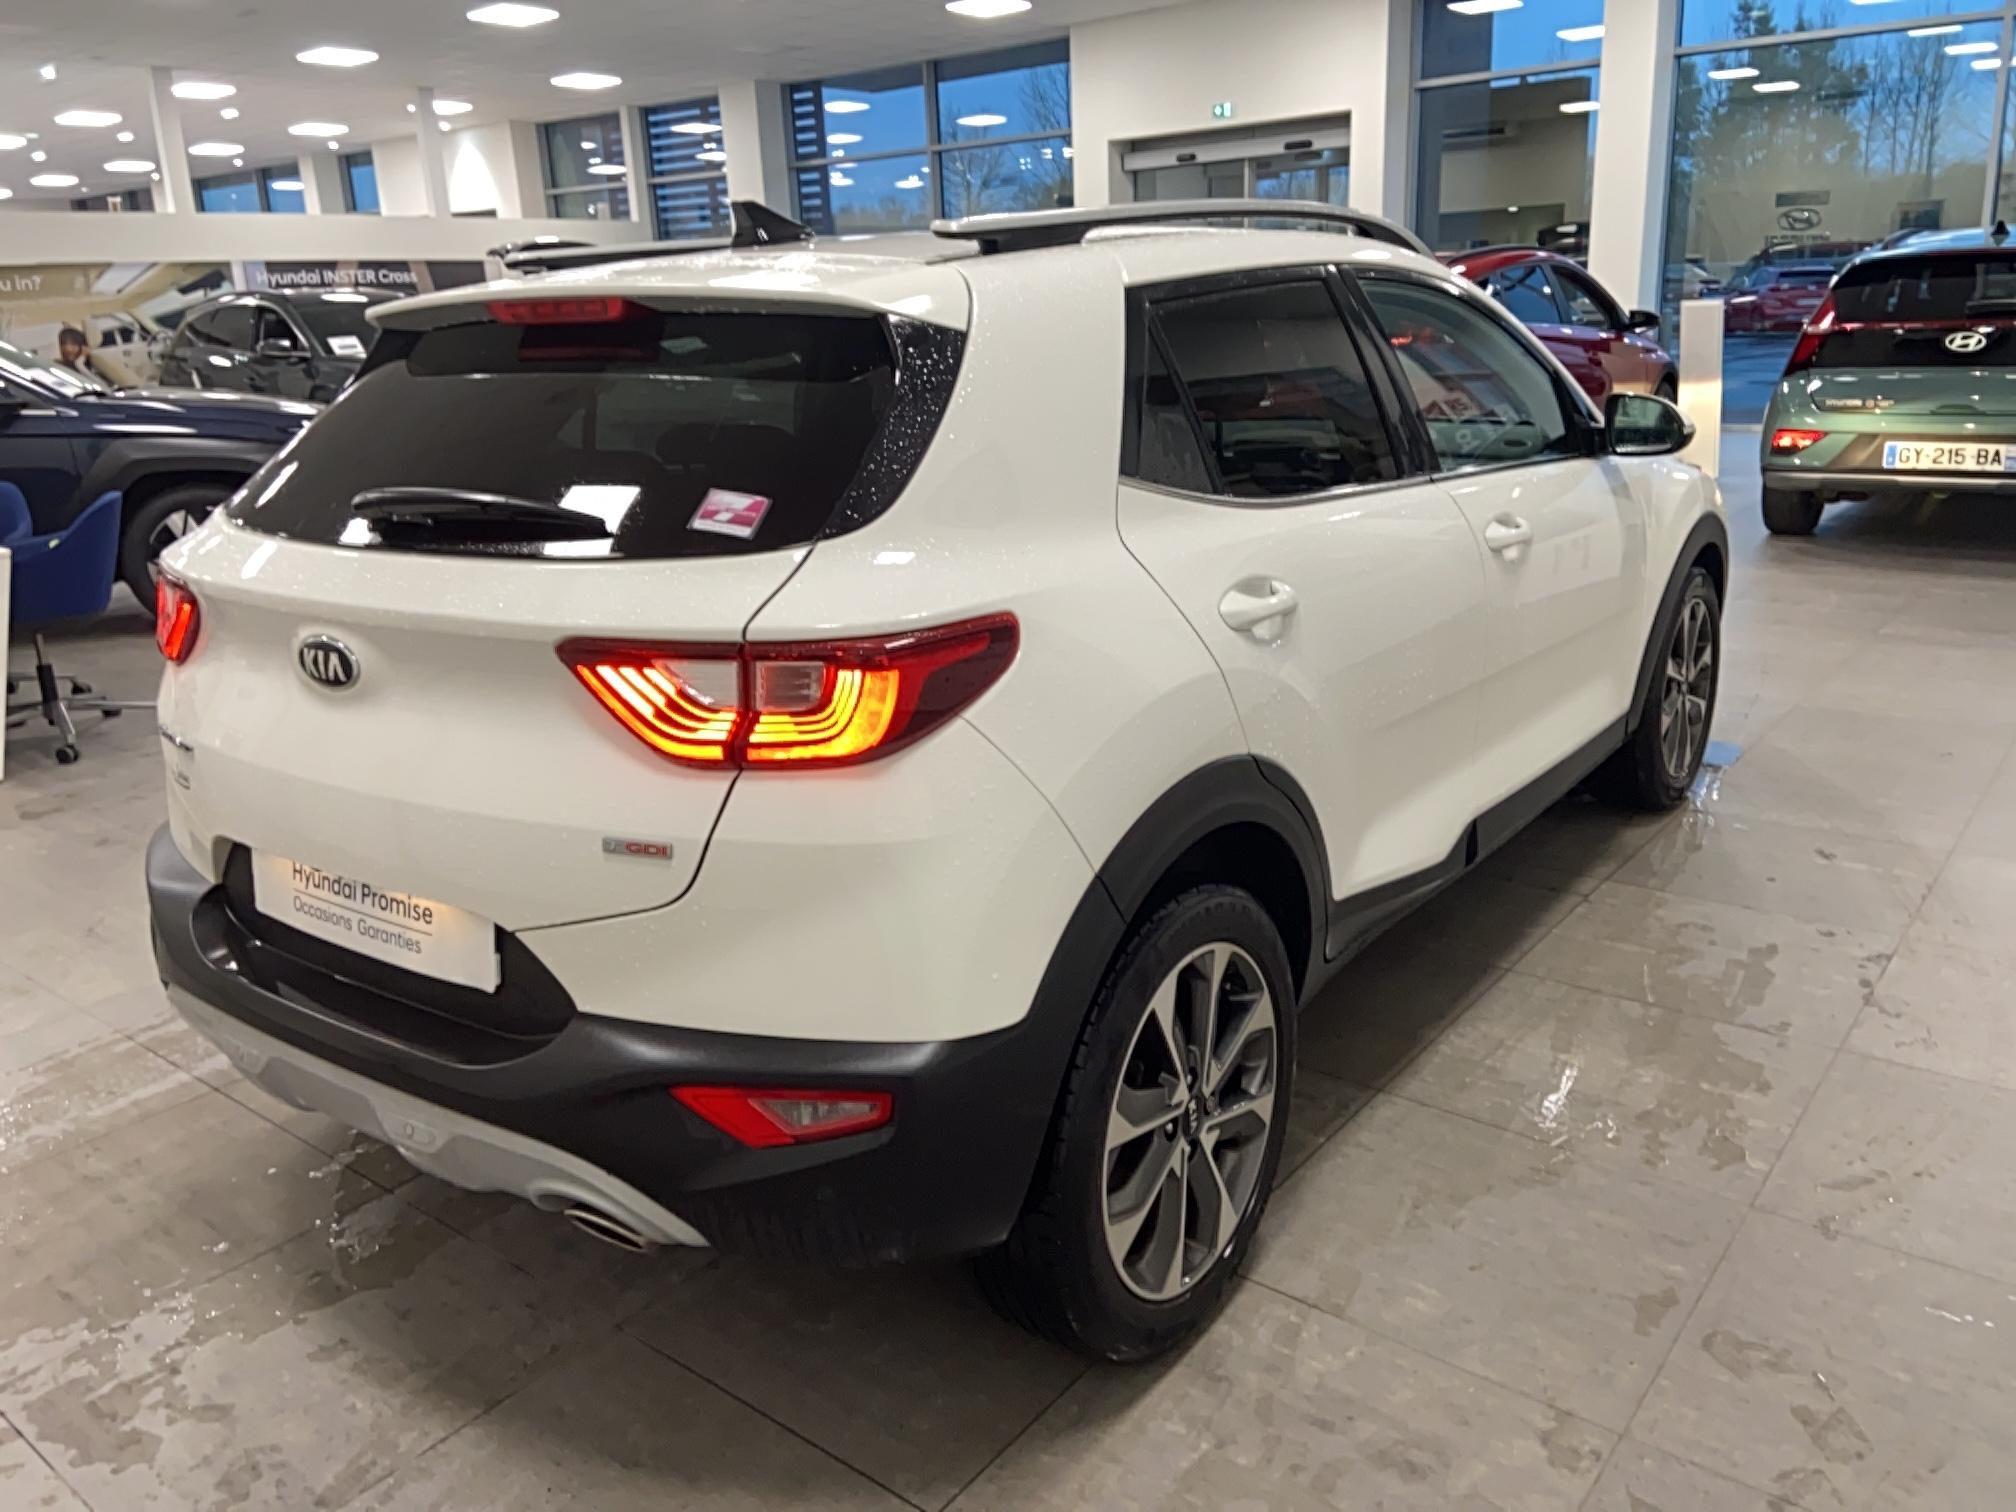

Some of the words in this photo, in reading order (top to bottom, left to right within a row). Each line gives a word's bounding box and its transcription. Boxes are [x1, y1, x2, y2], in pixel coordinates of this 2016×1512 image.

[255, 269, 321, 287] Hyundai
[323, 269, 376, 284] INSTER
[378, 269, 418, 283] Cross
[303, 647, 347, 682] KIA
[360, 882, 433, 925] Promise
[293, 895, 353, 932] Occasions
[356, 917, 423, 954] Garanties
